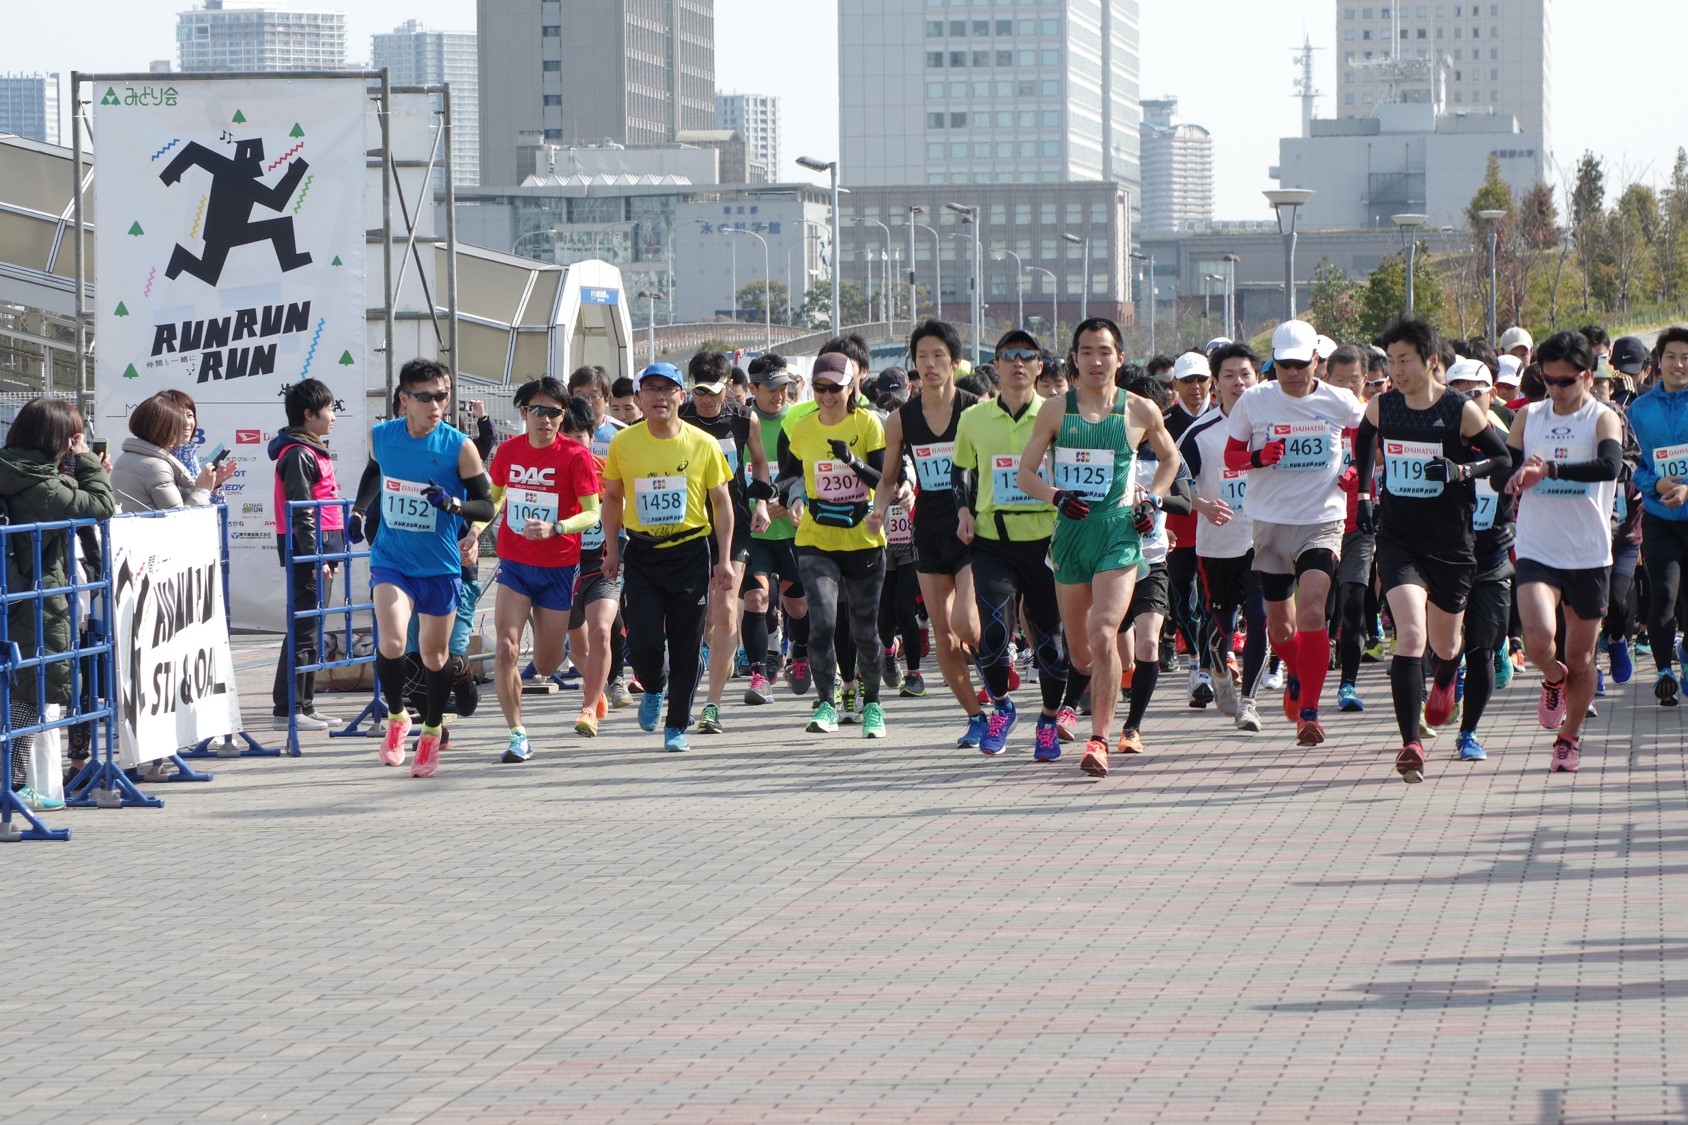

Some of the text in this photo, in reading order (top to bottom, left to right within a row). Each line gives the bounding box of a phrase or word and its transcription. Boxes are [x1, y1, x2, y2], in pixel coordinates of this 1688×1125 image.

[124, 86, 179, 107] みどり会
[722, 206, 759, 215] 東京都
[700, 221, 782, 235] 水の科学館
[196, 343, 278, 384] RUN
[1404, 447, 1438, 455] DAIHATSU
[509, 463, 556, 487] DAC
[922, 458, 951, 477] 112
[1063, 465, 1105, 485] 1125
[1392, 460, 1426, 480] 119
[822, 475, 860, 491] 2307
[388, 495, 429, 518] 1152
[641, 492, 682, 511] 1458
[513, 504, 551, 522] 1067
